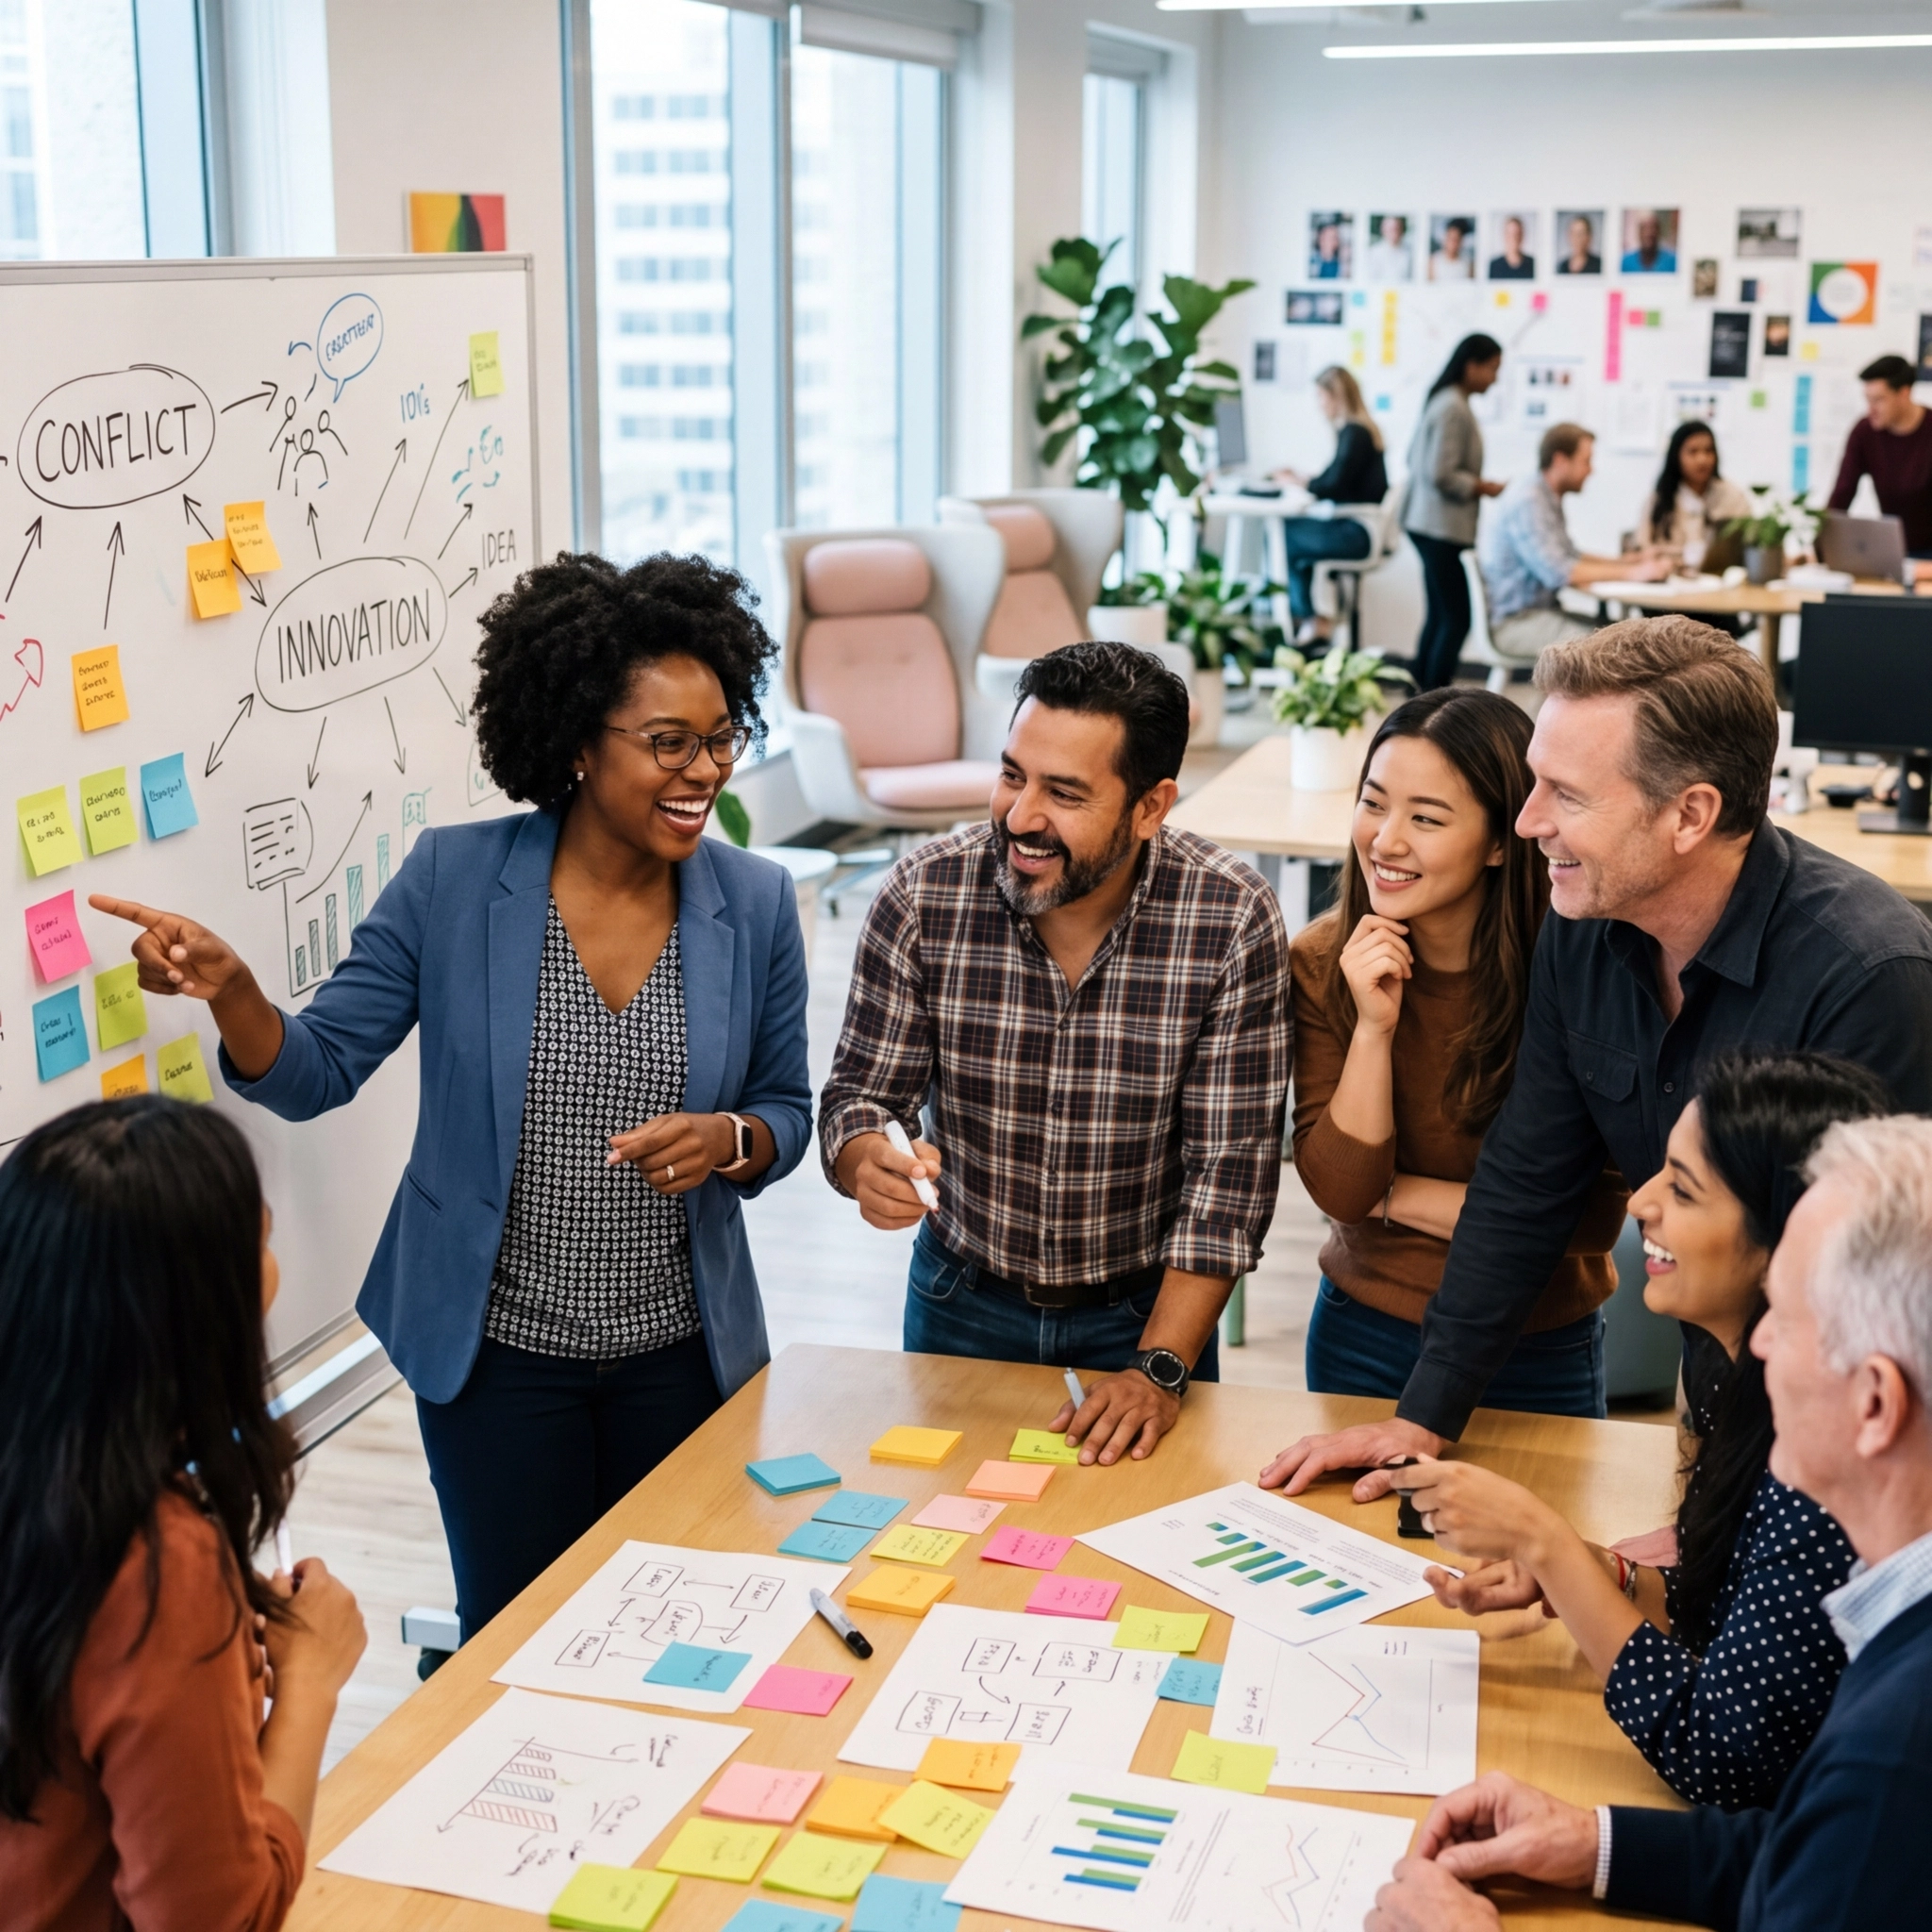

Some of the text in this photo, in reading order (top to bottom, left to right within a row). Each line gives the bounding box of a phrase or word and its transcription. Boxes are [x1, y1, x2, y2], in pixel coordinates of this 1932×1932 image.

[36, 403, 196, 482] CONFLICT
[481, 528, 517, 570] IDEA
[277, 588, 430, 684] INNOVATION
